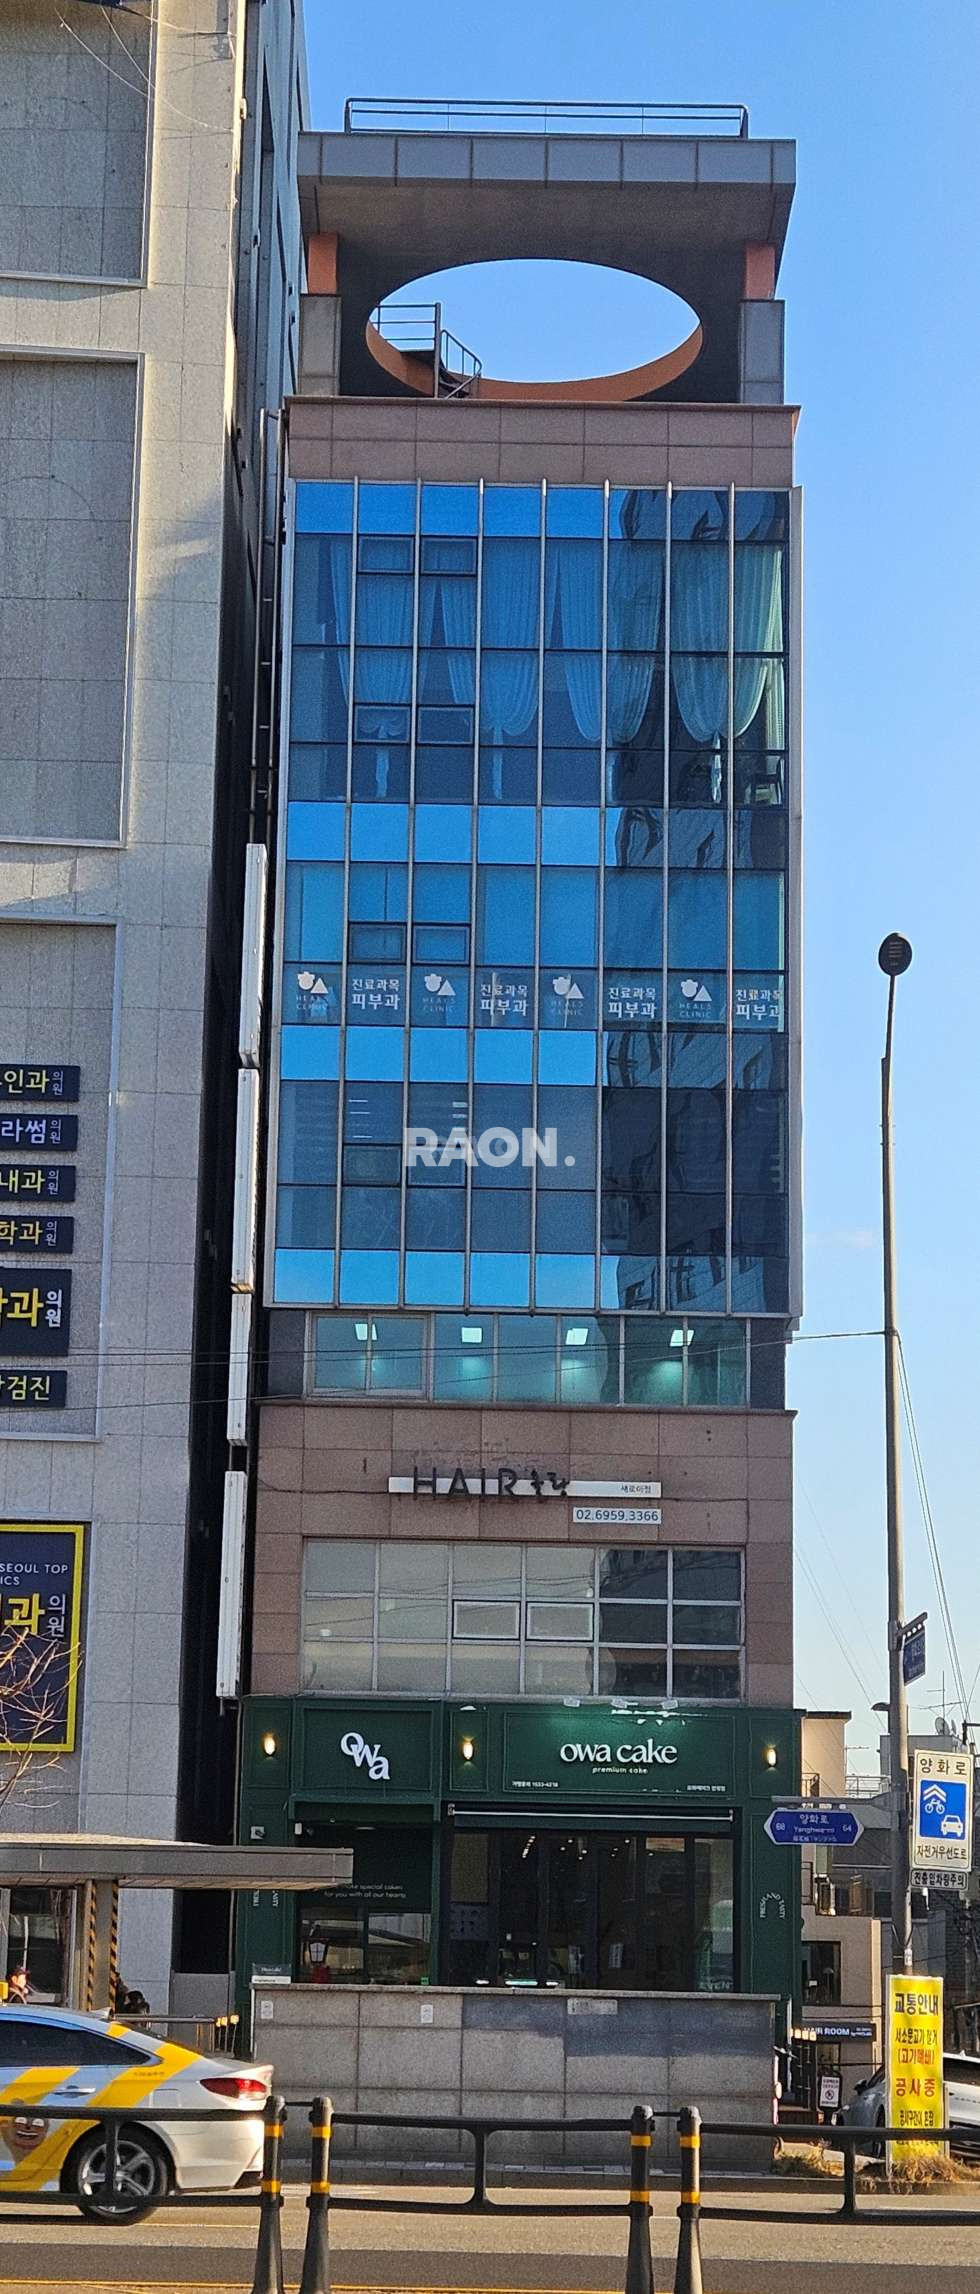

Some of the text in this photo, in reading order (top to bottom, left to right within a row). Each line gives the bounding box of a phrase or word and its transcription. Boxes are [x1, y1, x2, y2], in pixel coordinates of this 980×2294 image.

[352, 978, 400, 991] 진료과목
[480, 983, 528, 996] 진료과목
[351, 993, 401, 1011] 피부과
[607, 987, 656, 1000] 진료과목
[479, 999, 528, 1017] 피부과
[607, 1002, 657, 1019] 피부과
[0, 1069, 50, 1094] 인과
[0, 1287, 45, 1328] 과
[0, 1375, 51, 1400] 검진
[413, 1466, 517, 1498] HAIR
[576, 1508, 659, 1522] 02.6959.3366
[0, 1563, 68, 1574] SEOUL TOP
[560, 1738, 678, 1764] owa cake
[592, 1766, 648, 1775] premium cake
[919, 1758, 968, 1776] 양화로
[799, 1814, 830, 1825] 양화로
[916, 1845, 967, 1860] 자전거우선도로
[914, 1871, 965, 1887] 진출입차량주의
[894, 1992, 939, 2016] 교통안내
[824, 2026, 850, 2036] ROOM
[895, 2078, 936, 2098] 공사중
